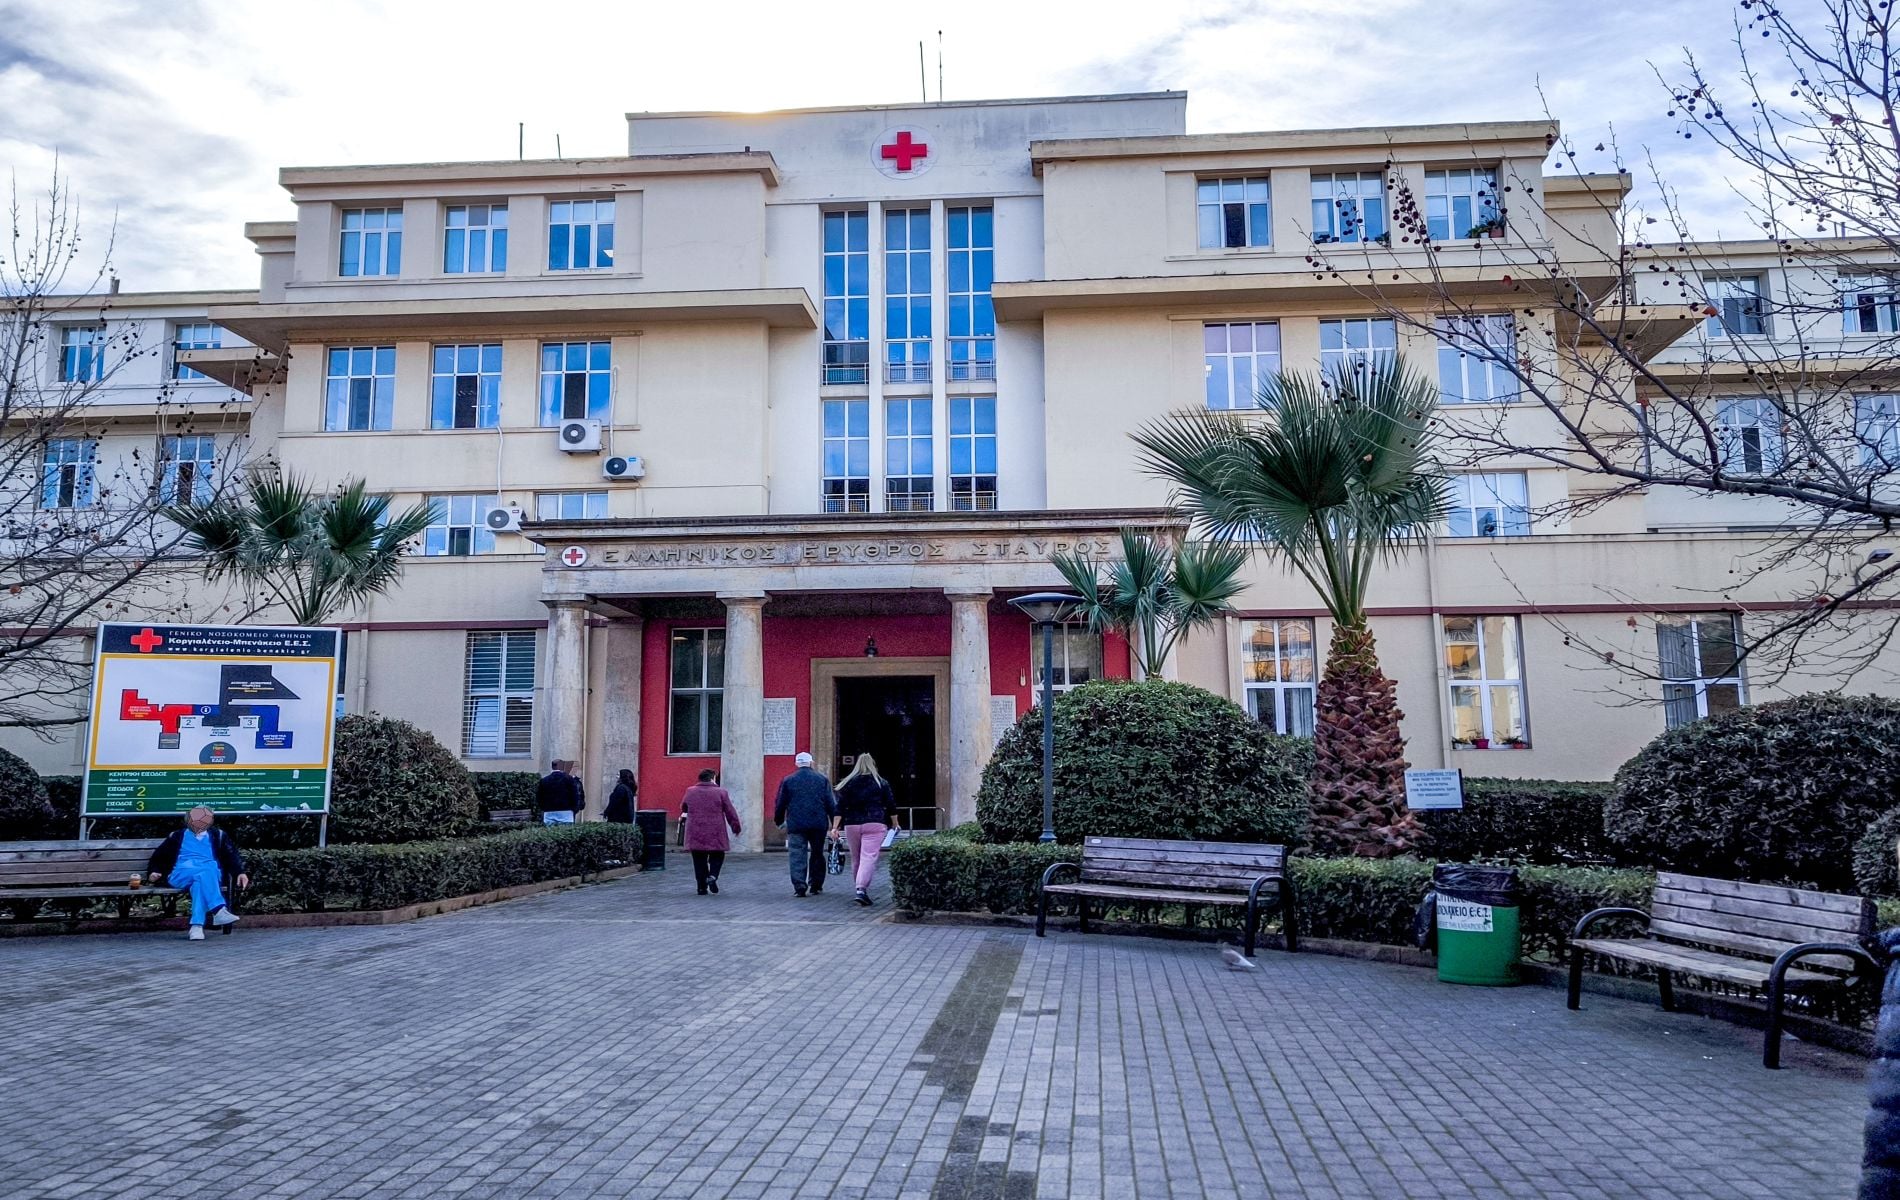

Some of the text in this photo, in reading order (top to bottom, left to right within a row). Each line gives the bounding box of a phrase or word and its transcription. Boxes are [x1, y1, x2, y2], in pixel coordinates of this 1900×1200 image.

[602, 541, 1110, 563] ΕΛΛΗΝΙΚΟΣ ΕΡΥΘΡΟΣ ΣΤΑΥΡΟΣ
[136, 786, 146, 797] 2
[136, 800, 145, 811] 3
